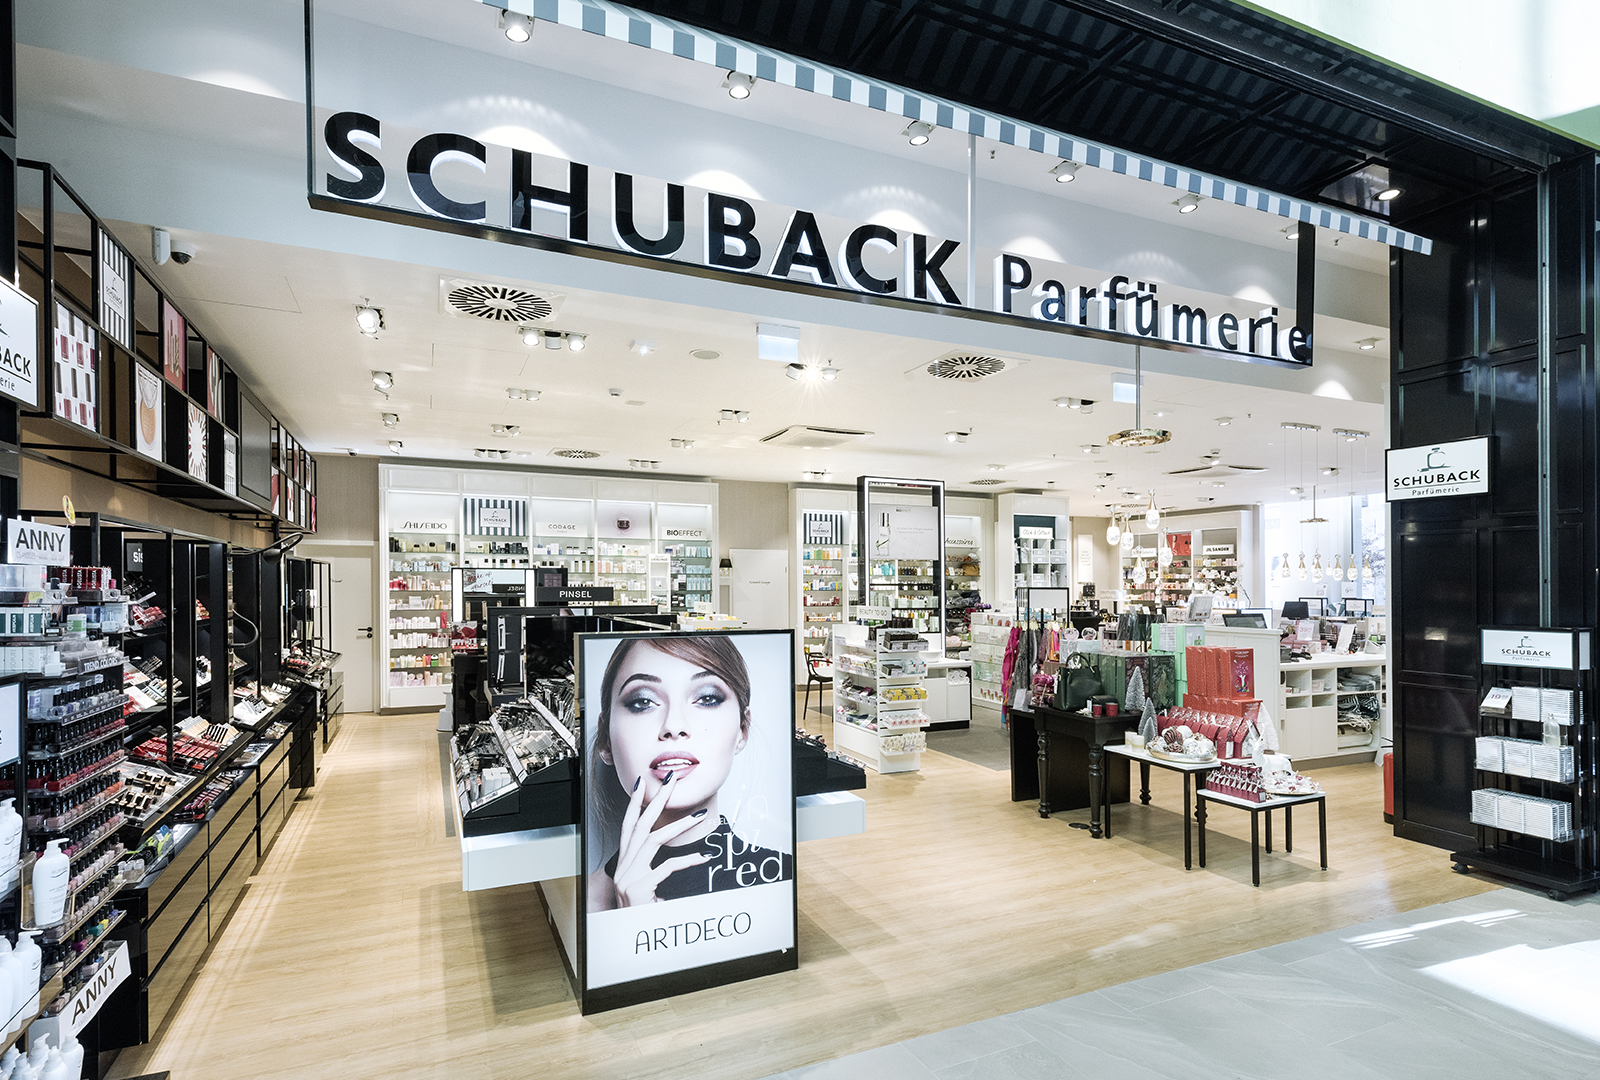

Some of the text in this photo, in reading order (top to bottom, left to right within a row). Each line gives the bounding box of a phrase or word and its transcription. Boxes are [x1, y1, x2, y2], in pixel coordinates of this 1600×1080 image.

[324, 111, 1307, 363] SCHUBACK Parfümerie
[1394, 470, 1480, 488] SCHUBACK
[1412, 486, 1459, 496] Parfümerie
[400, 521, 447, 529] SHISEIDO
[667, 529, 702, 537] BIOEFFECT
[16, 528, 65, 552] ANNY
[559, 590, 592, 598] PINSEL
[708, 846, 783, 892] red
[635, 912, 752, 955] ARTDECO
[72, 957, 118, 1025] ANNY
